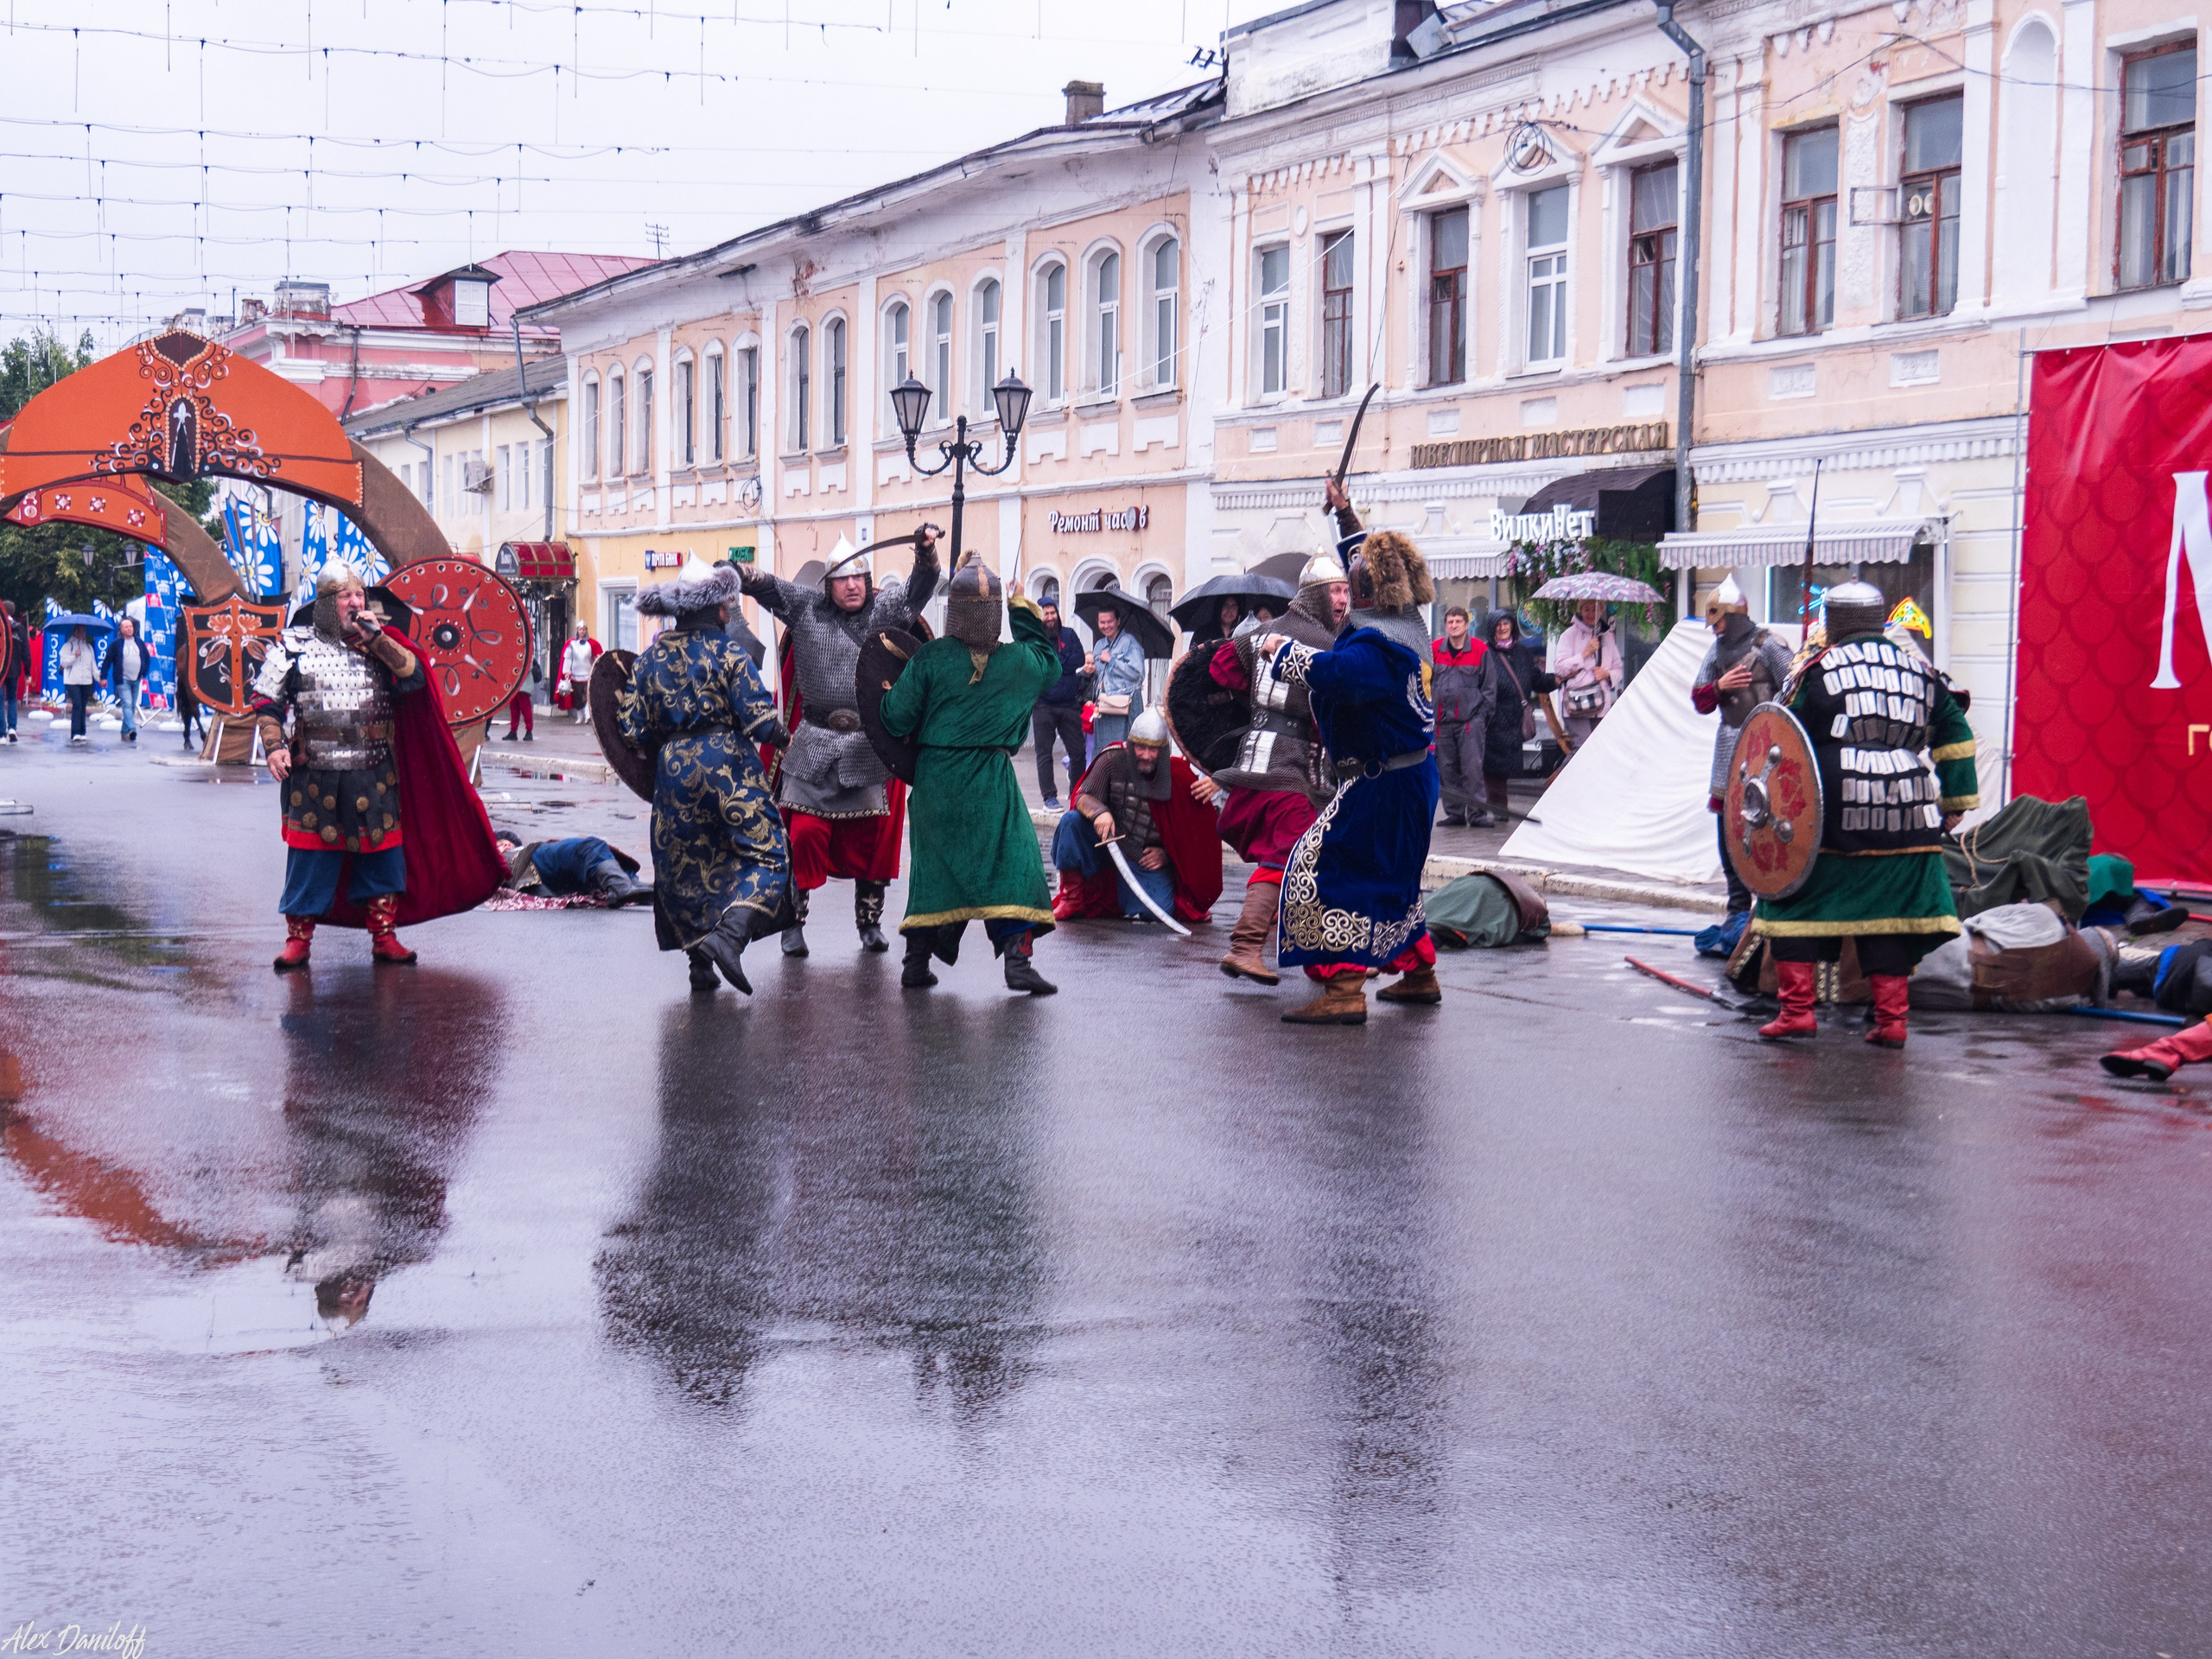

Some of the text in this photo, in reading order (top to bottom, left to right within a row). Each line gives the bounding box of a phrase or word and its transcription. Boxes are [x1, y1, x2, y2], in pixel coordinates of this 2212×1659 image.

[1409, 421, 1669, 469] ЮВЕЛИРНАЯ МАСТЕРСКАЯ
[1048, 507, 1102, 532] Ремонт
